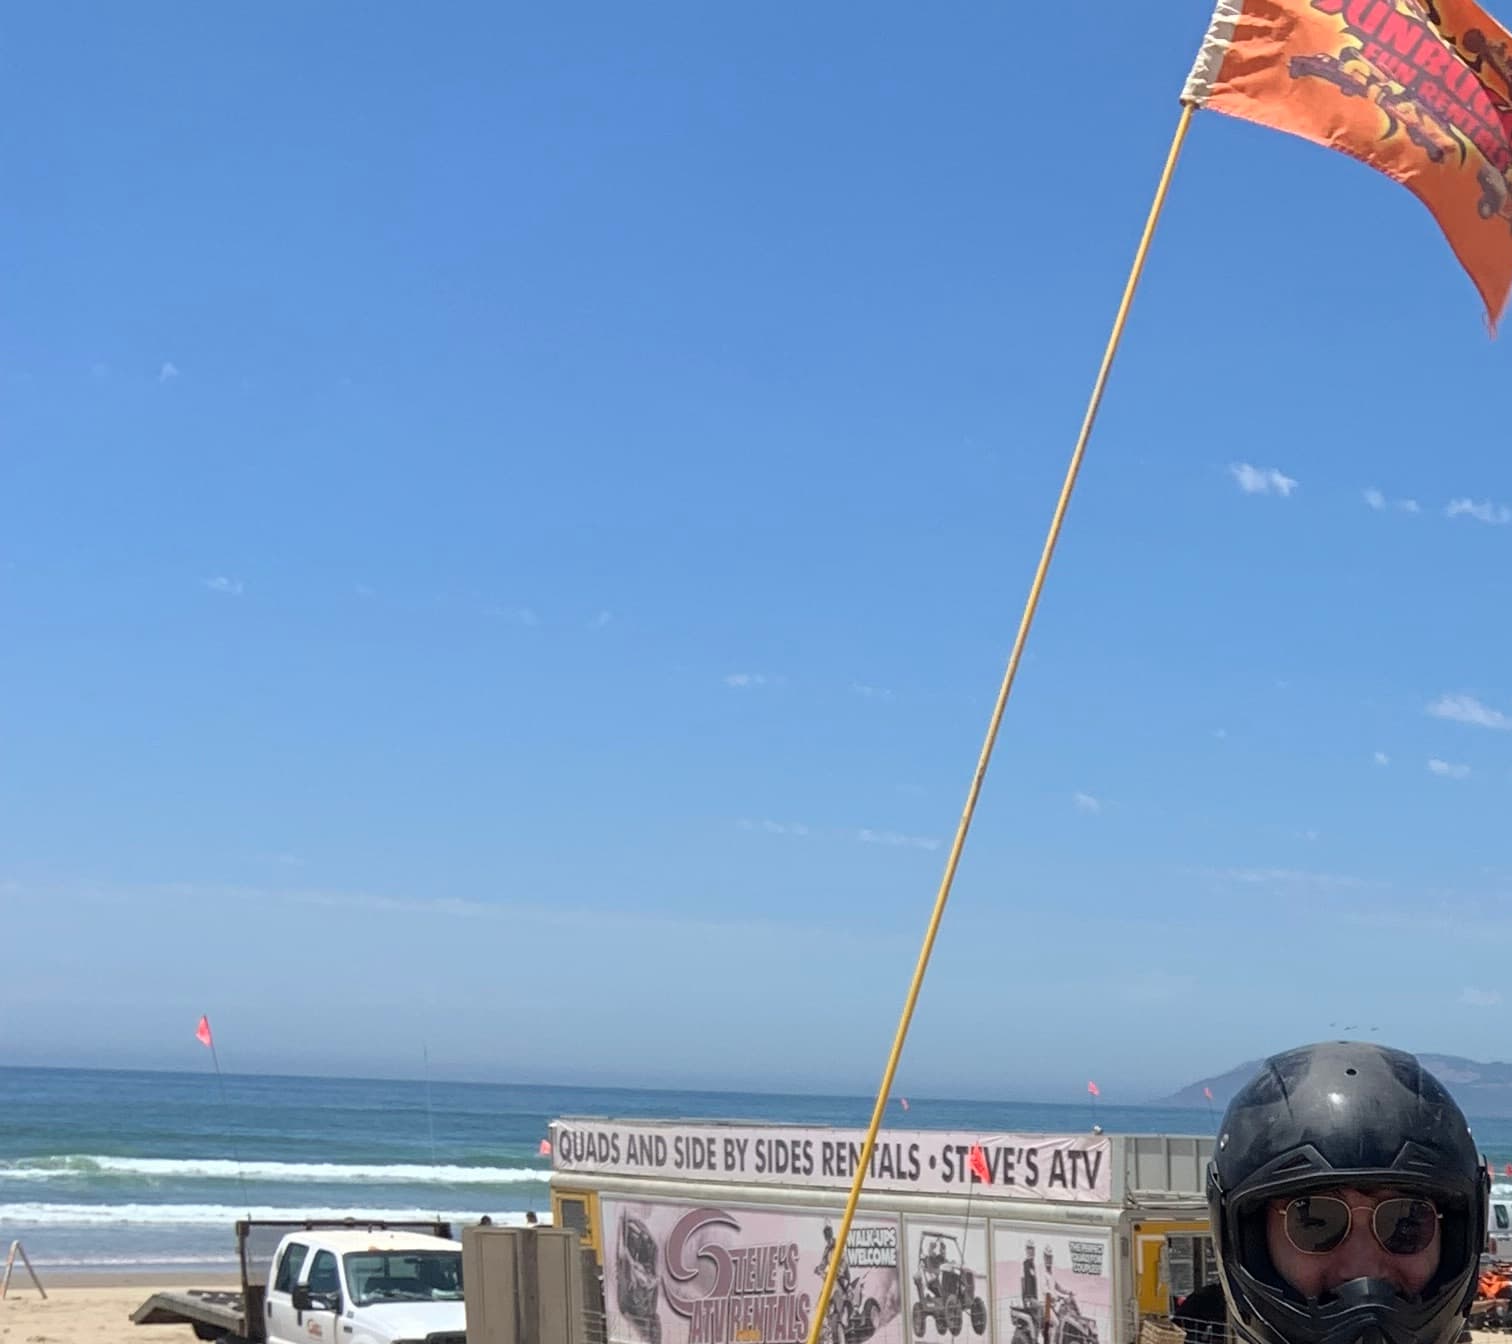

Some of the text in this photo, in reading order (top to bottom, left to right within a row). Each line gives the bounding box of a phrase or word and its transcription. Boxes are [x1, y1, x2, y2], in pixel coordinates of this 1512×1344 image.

[559, 1130, 621, 1164] QUADS
[626, 1133, 667, 1167] AND
[674, 1136, 717, 1170] SIDE
[724, 1138, 749, 1172] BY
[755, 1139, 815, 1176] SIDES
[1048, 1149, 1103, 1190] ATV
[847, 1228, 897, 1248] WALK-UPS
[847, 1247, 897, 1267] WELCOME
[663, 1208, 799, 1312] STEVE'S
